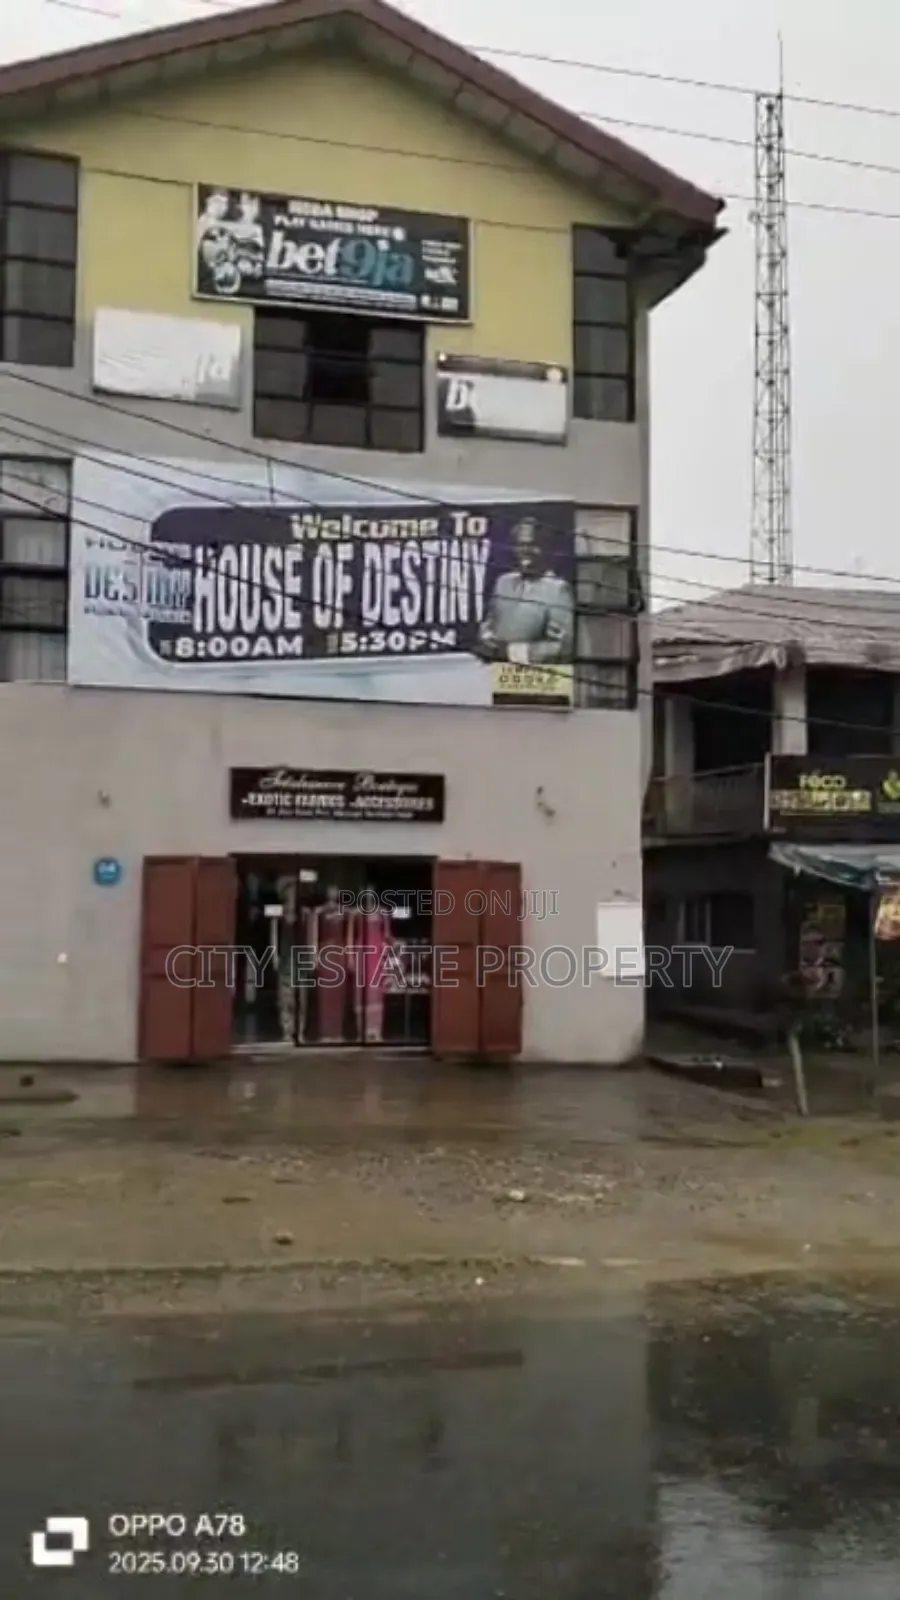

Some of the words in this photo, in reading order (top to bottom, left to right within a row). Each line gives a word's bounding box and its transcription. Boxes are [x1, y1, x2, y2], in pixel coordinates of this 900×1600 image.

[266, 230, 415, 287] bet9ja
[289, 512, 439, 540] Welcome
[450, 510, 488, 537] To
[192, 542, 304, 634] HOUSE
[312, 541, 353, 630] OF
[360, 537, 492, 627] DESTINY
[174, 635, 304, 659] 8:00AM
[340, 629, 457, 653] 5:30PM
